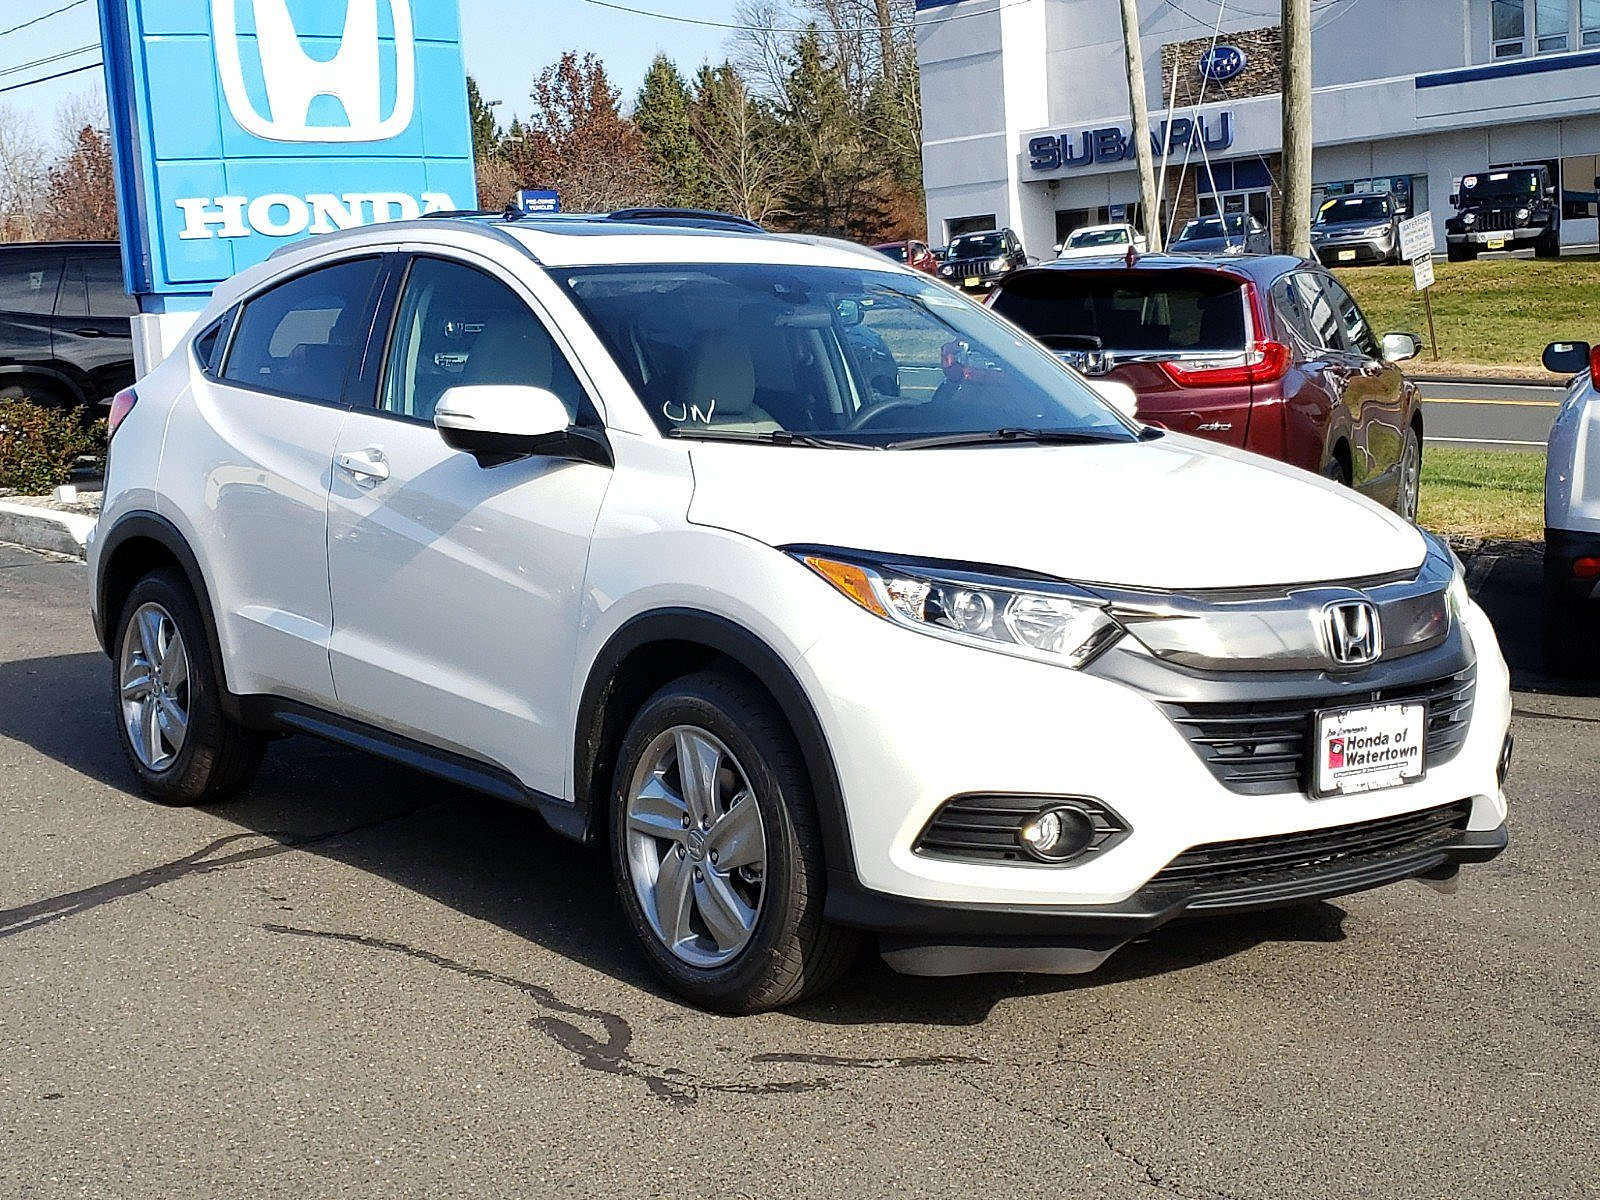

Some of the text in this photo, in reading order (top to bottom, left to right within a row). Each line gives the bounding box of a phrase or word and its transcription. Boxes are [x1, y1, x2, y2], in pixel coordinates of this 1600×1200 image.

[1346, 732, 1389, 751] Honda
[1394, 727, 1409, 743] of
[1345, 745, 1418, 767] Watertown
